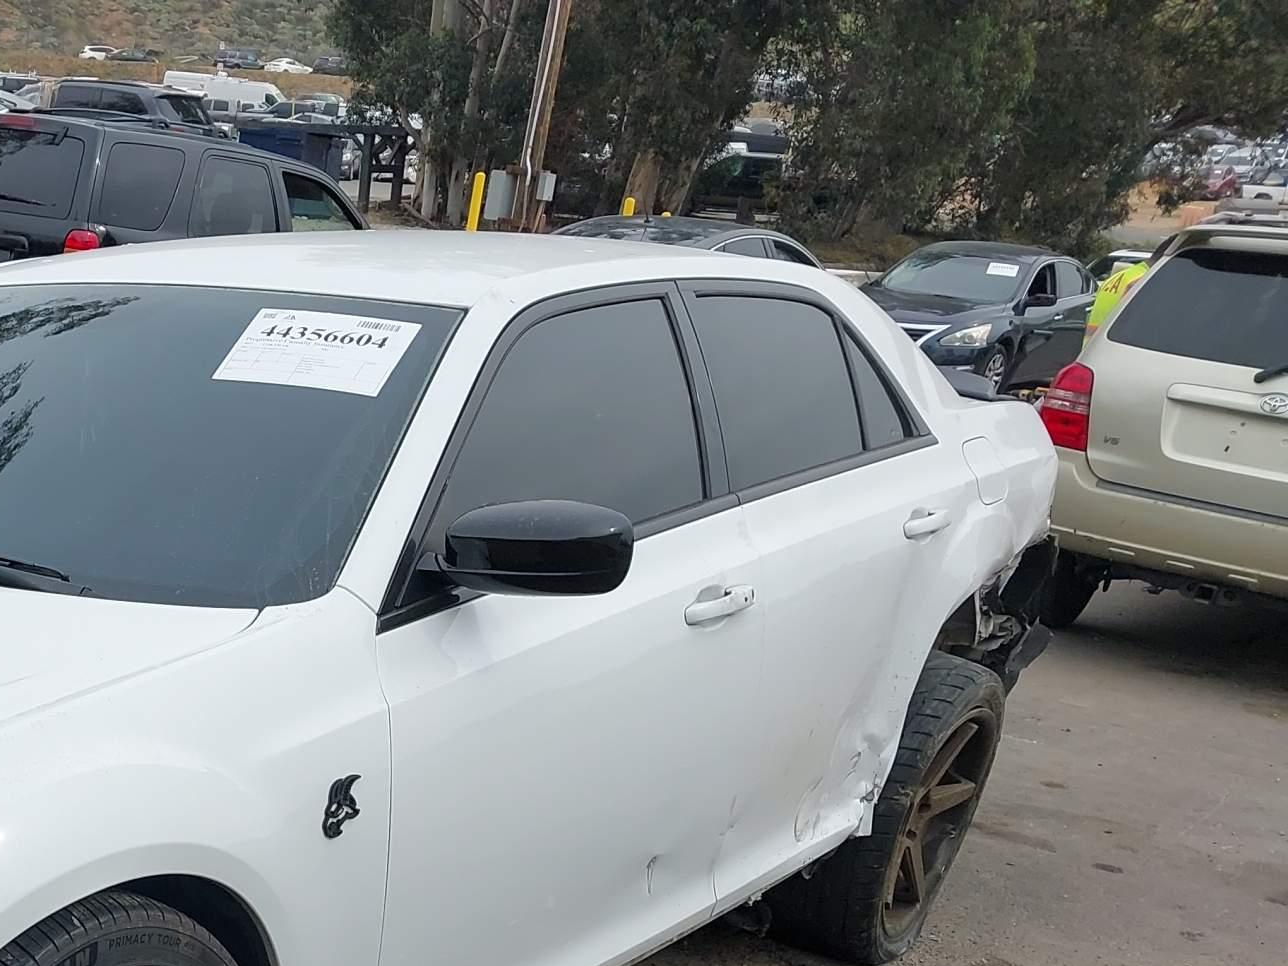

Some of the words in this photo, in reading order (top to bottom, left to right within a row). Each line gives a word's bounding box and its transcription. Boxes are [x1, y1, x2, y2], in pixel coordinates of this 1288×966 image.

[261, 324, 389, 349] 44356604
[108, 932, 155, 951] PRIMACY
[157, 933, 182, 948] TOUR
